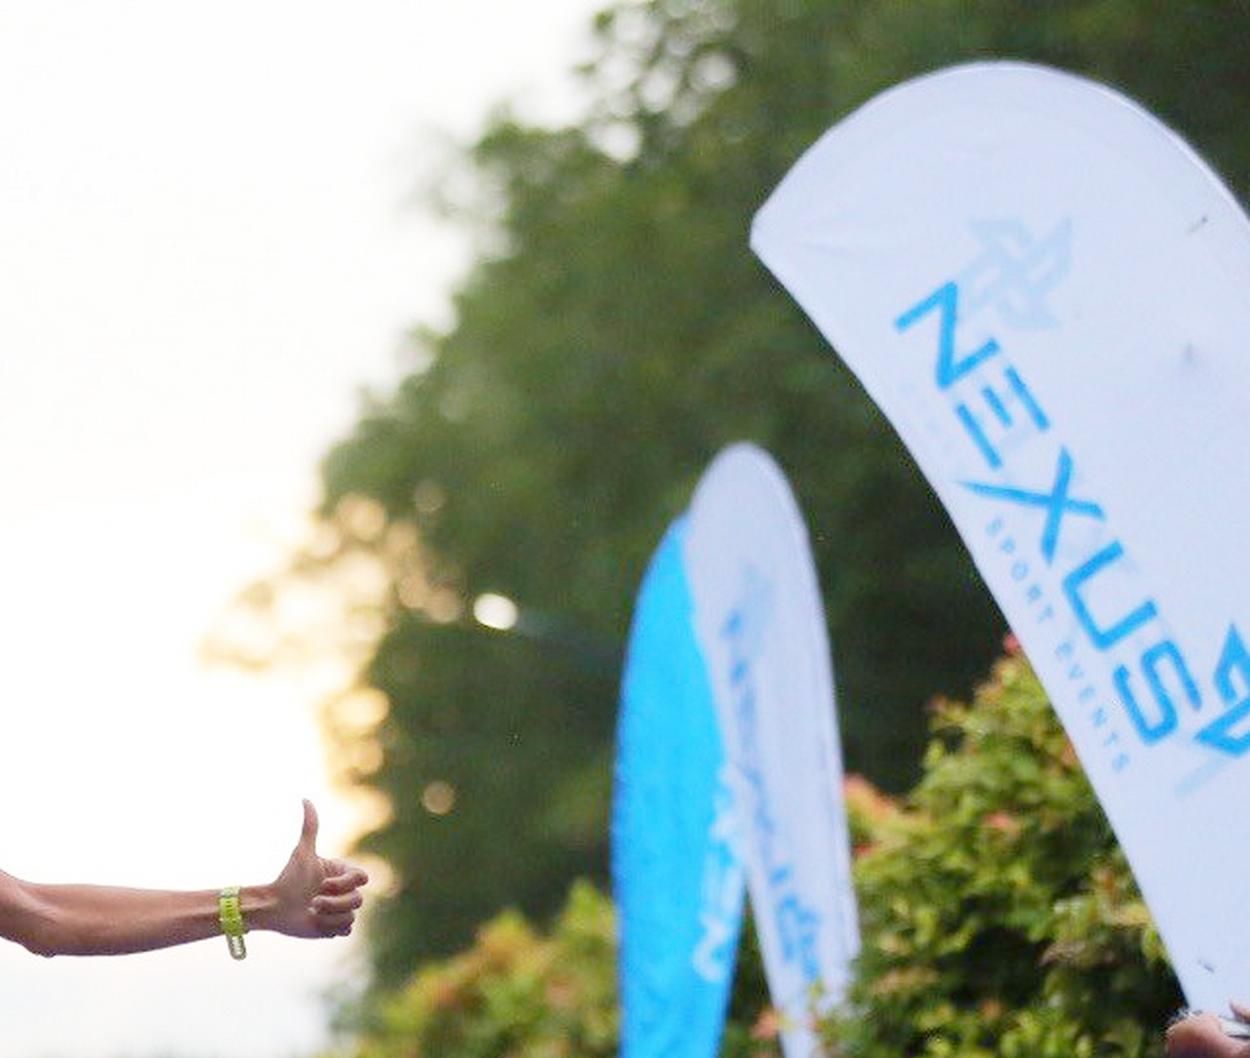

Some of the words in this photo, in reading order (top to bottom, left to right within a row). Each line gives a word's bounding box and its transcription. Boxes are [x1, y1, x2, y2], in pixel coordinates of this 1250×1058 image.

[892, 279, 1203, 747] NEXUS
[985, 518, 1059, 625] SPORT
[1055, 641, 1132, 774] EVENTS
